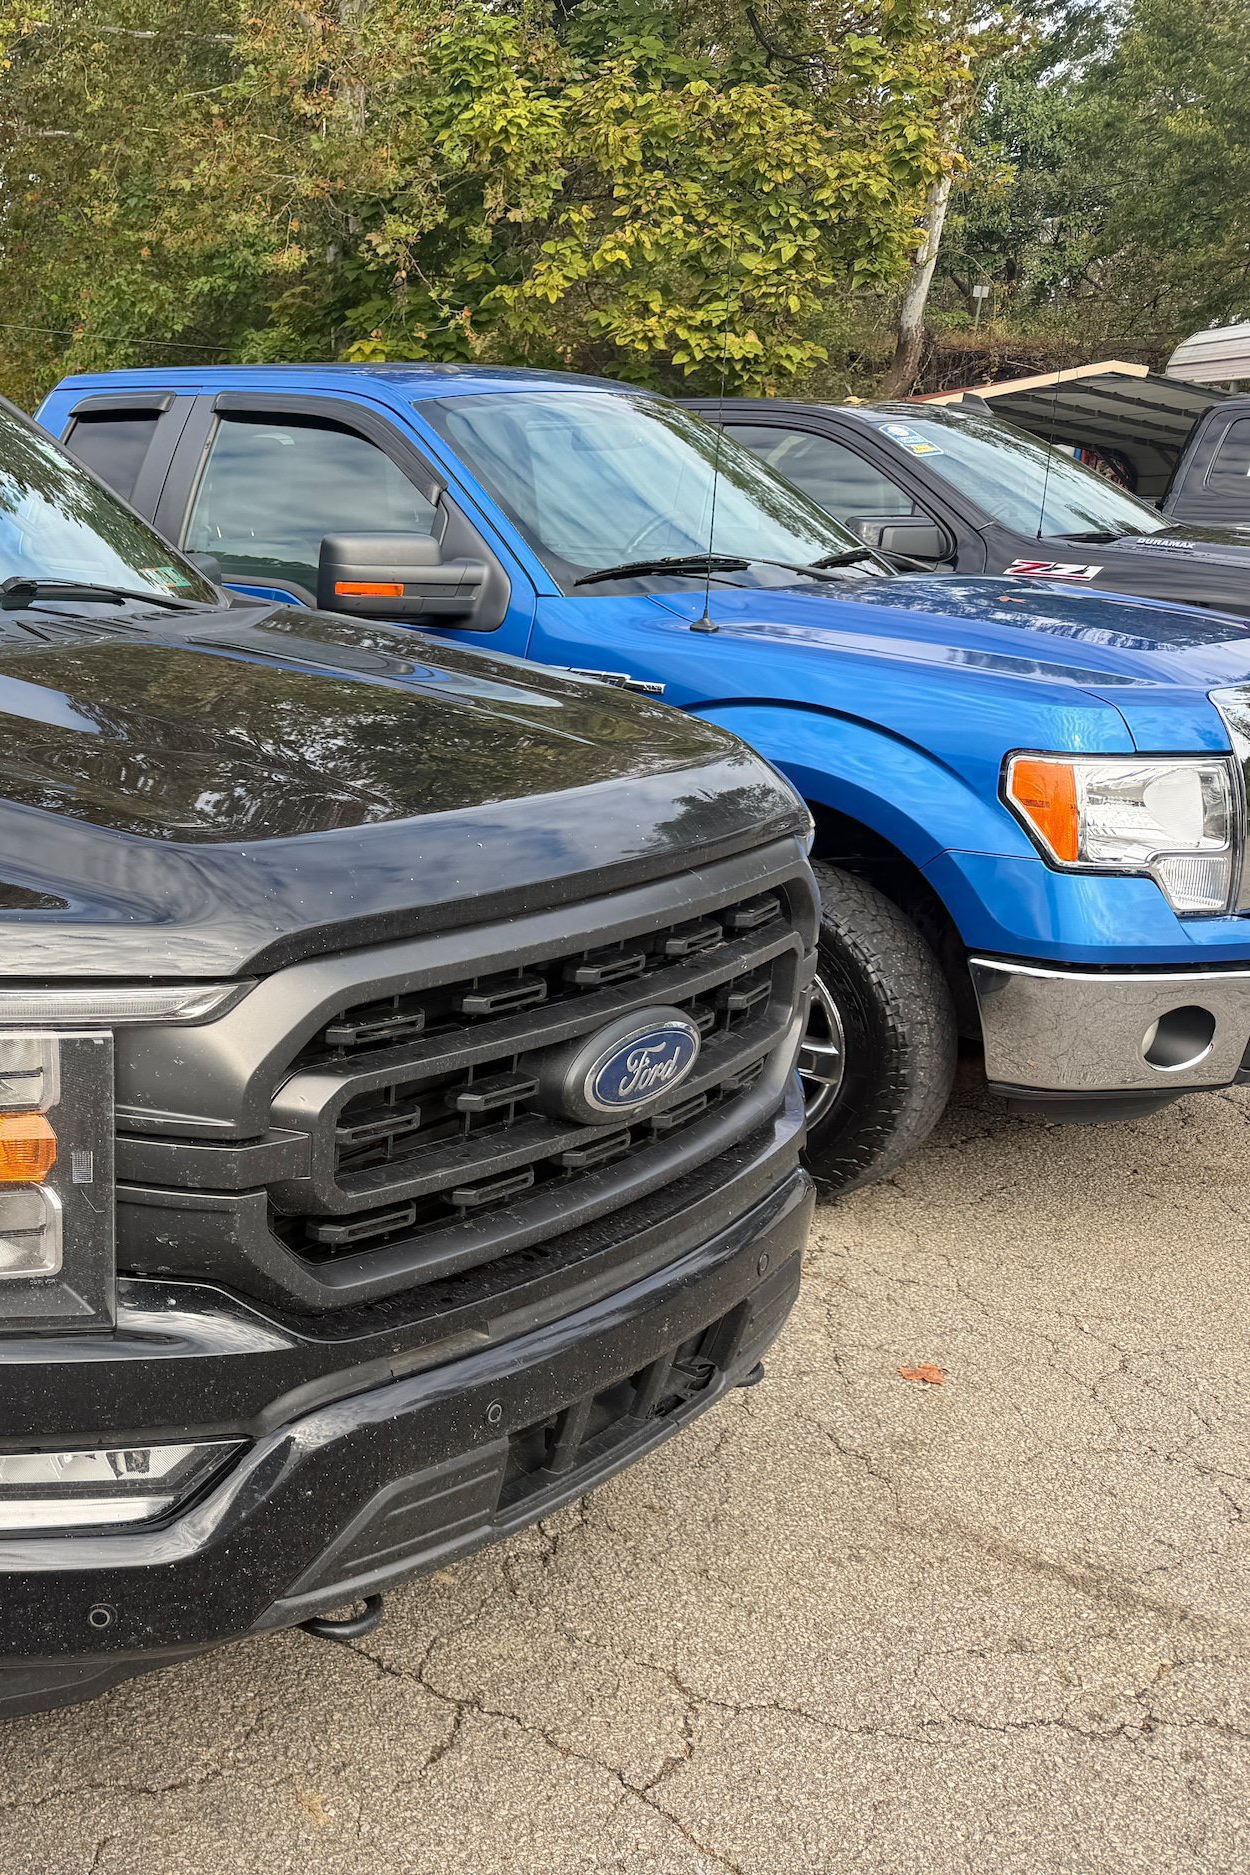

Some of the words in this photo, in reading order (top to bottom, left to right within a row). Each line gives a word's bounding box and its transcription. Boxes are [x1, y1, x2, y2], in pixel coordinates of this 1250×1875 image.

[1136, 538, 1195, 549] DURAMAX
[1003, 559, 1104, 581] Z71
[618, 1041, 681, 1097] Ford
